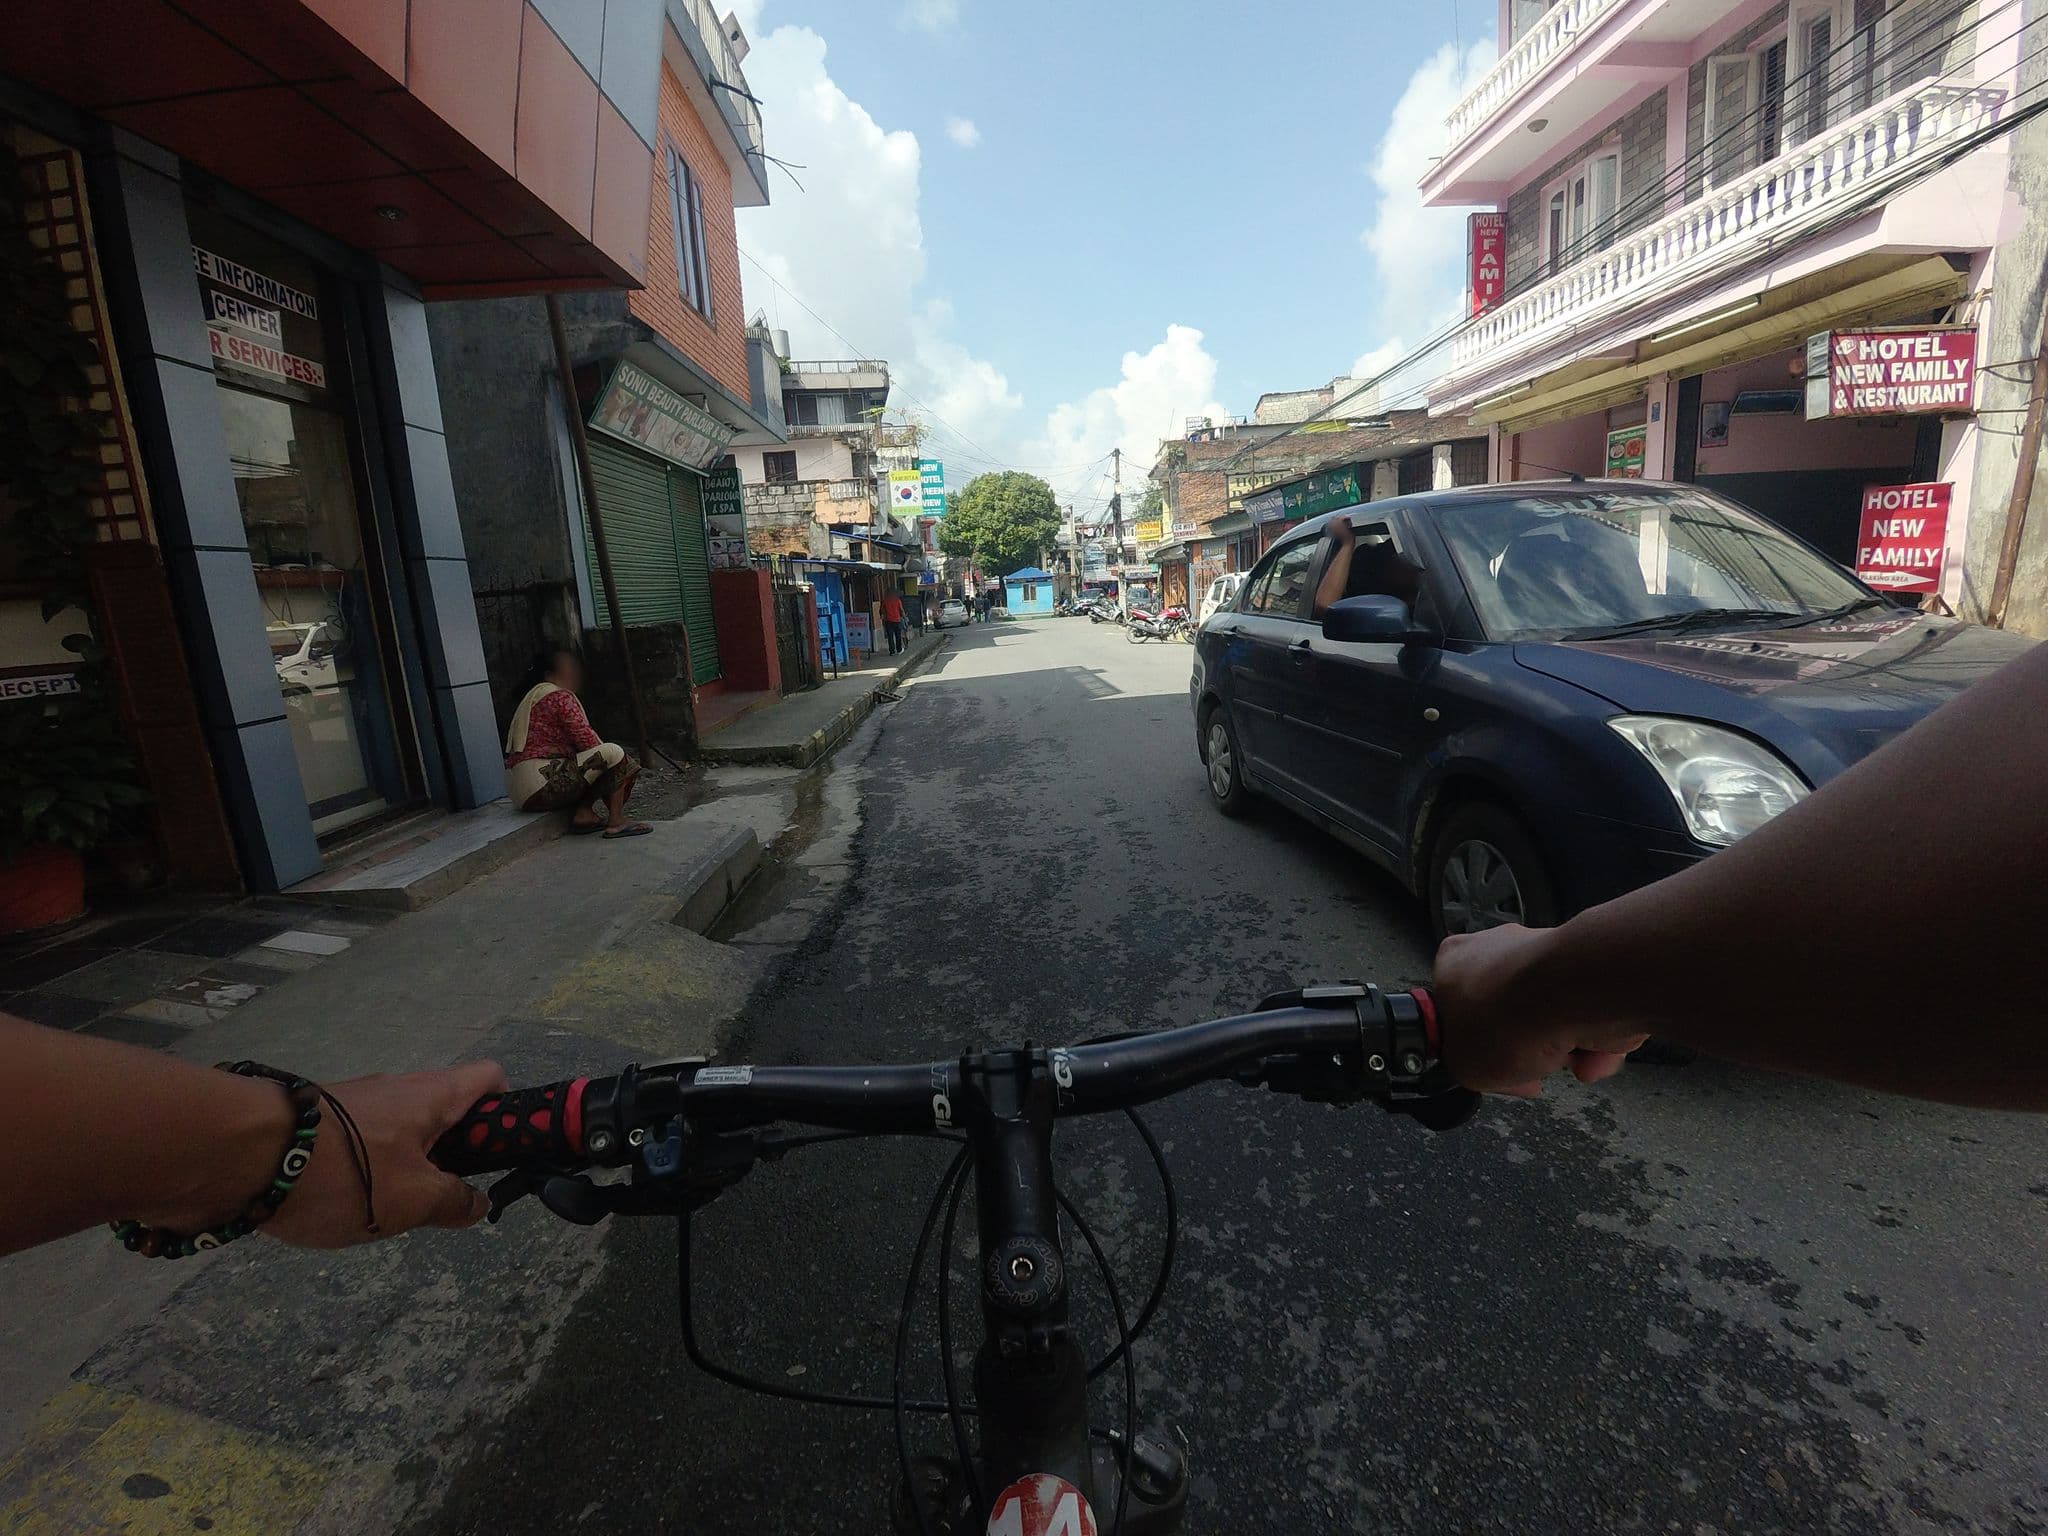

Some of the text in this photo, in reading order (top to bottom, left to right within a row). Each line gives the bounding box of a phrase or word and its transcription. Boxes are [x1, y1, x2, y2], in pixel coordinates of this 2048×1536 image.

[1475, 214, 1504, 228] HOTEL
[214, 257, 316, 318] INFORMATON
[214, 294, 279, 336] CENTER
[1859, 337, 1948, 360] HOTEL
[1835, 358, 1970, 385] NEW FAMILY
[618, 365, 732, 444] SONU BEAUTY PARLOUR & SPA
[1834, 382, 1969, 409] & RESTAURANT
[920, 463, 938, 472] NEW
[712, 502, 735, 513] & SPA
[922, 498, 941, 507] VIEW
[1867, 489, 1939, 510] HOTEL
[1872, 519, 1926, 538] NEW
[1860, 547, 1940, 567] FAMILY
